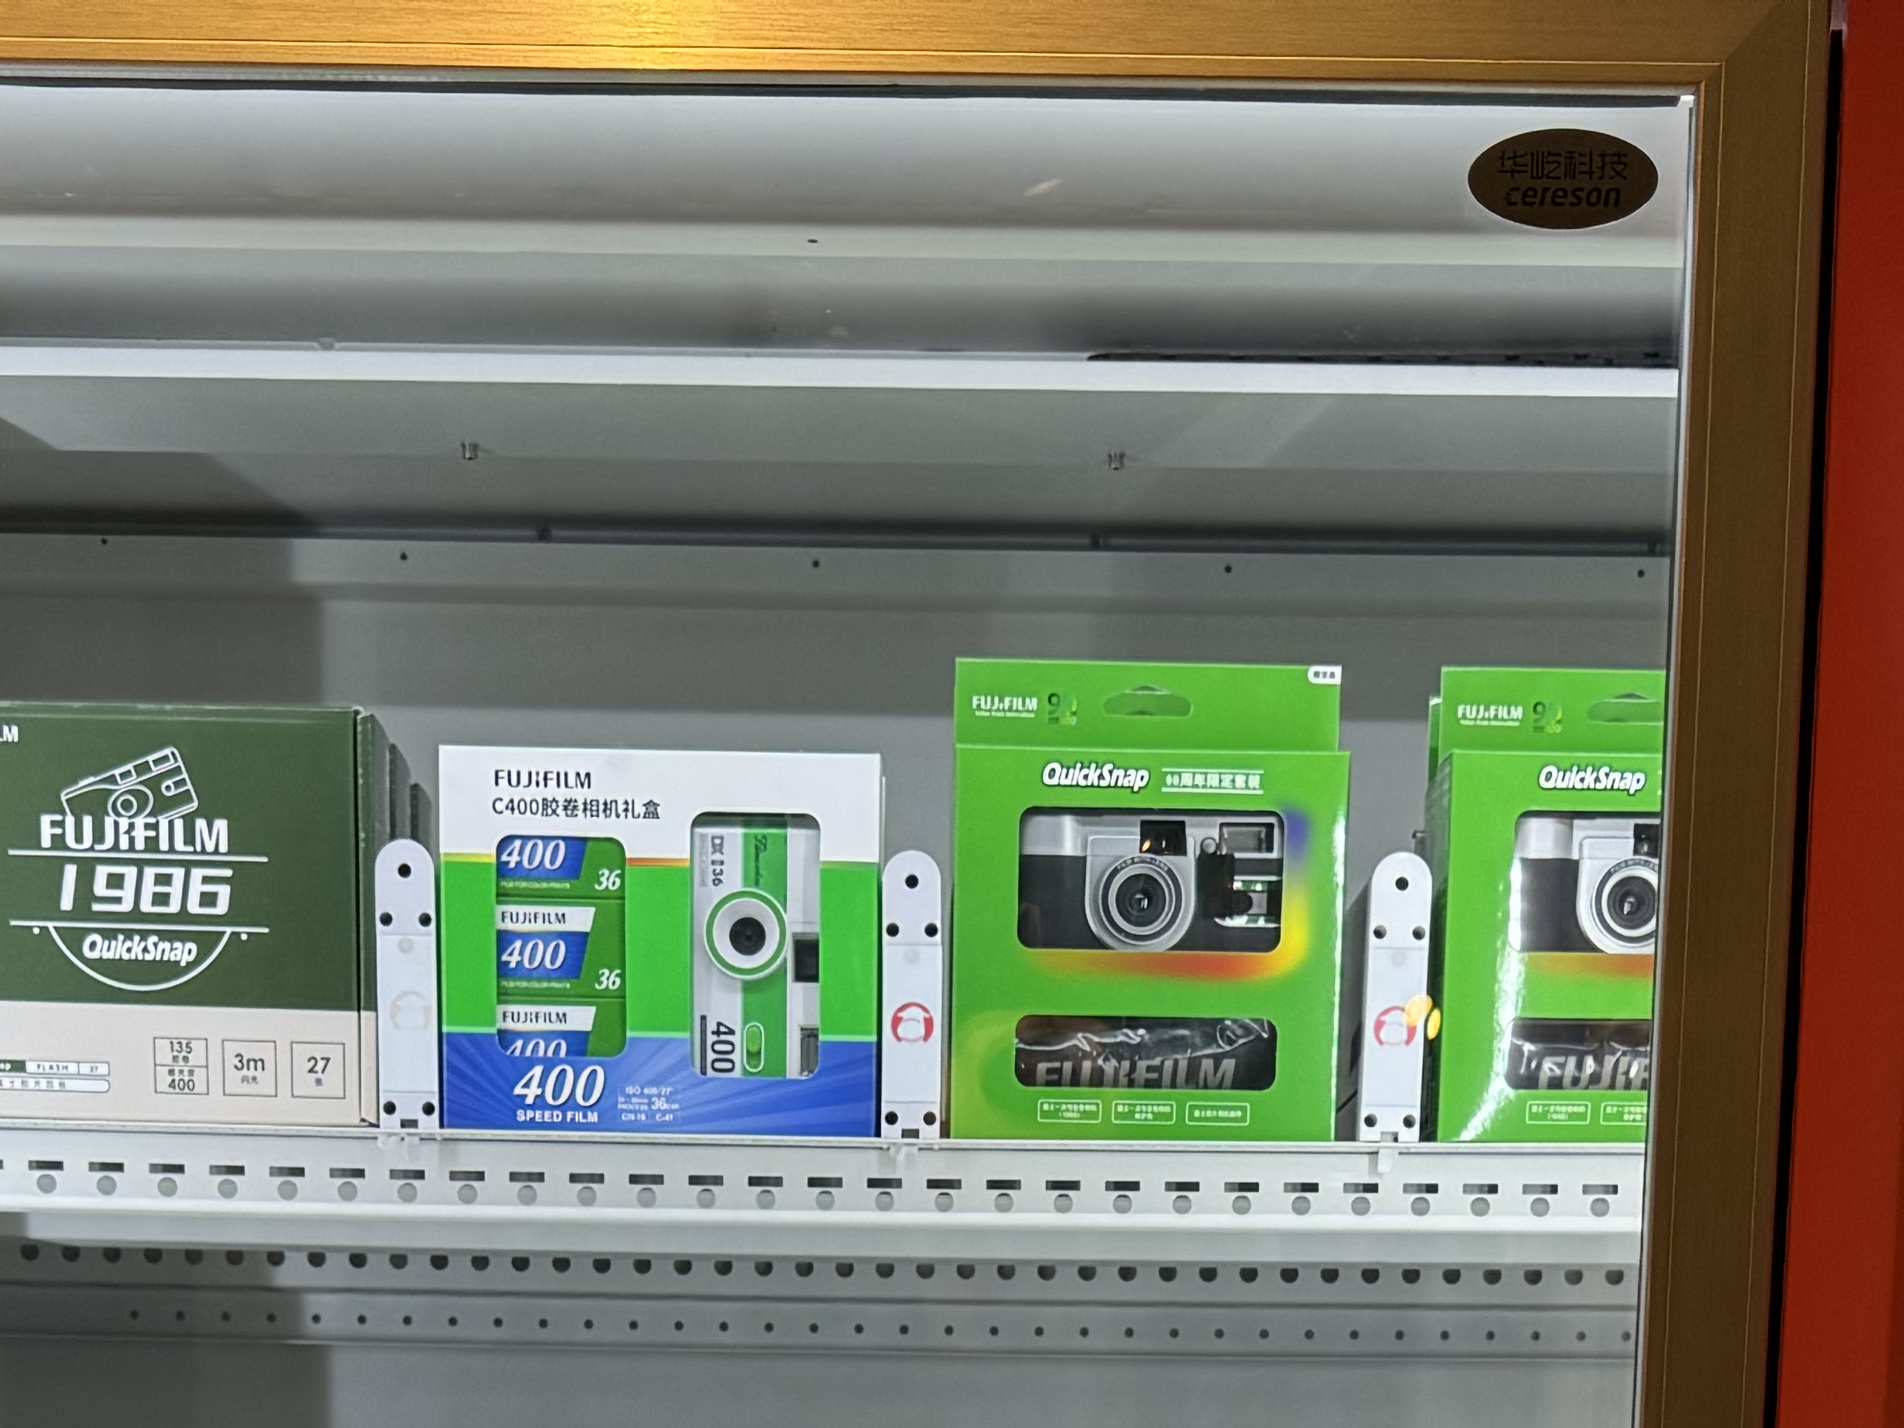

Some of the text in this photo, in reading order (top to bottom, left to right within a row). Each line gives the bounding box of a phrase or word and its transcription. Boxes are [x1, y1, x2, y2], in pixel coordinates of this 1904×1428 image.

[1497, 150, 1629, 181] 华屹科技
[1505, 186, 1622, 208] cereson
[972, 695, 1038, 712] FUJIFILM
[1457, 704, 1524, 720] FUJIFILM
[494, 769, 592, 790] FUJIFILM
[1042, 762, 1150, 792] QuickSnap
[1538, 764, 1647, 796] QuickSnap
[492, 797, 662, 820] C400胶卷相机礼盒
[39, 813, 230, 854] FUJIFILM
[500, 838, 566, 871] 400
[59, 863, 234, 916] 1986
[594, 868, 622, 891] 36
[501, 910, 567, 925] FUJIFILM
[82, 933, 198, 967] QuickSnap
[500, 939, 567, 970] 400
[594, 968, 622, 990] 36
[502, 1010, 568, 1025] FUJIFILM
[169, 1040, 193, 1054] 135
[710, 1020, 736, 1075] 400
[233, 1053, 266, 1072] 3m
[306, 1056, 332, 1075] 27
[1538, 1054, 1648, 1091] FUJIF
[167, 1078, 196, 1092] 400
[512, 1064, 606, 1107] 400
[516, 1109, 599, 1124] SPEED FILM
